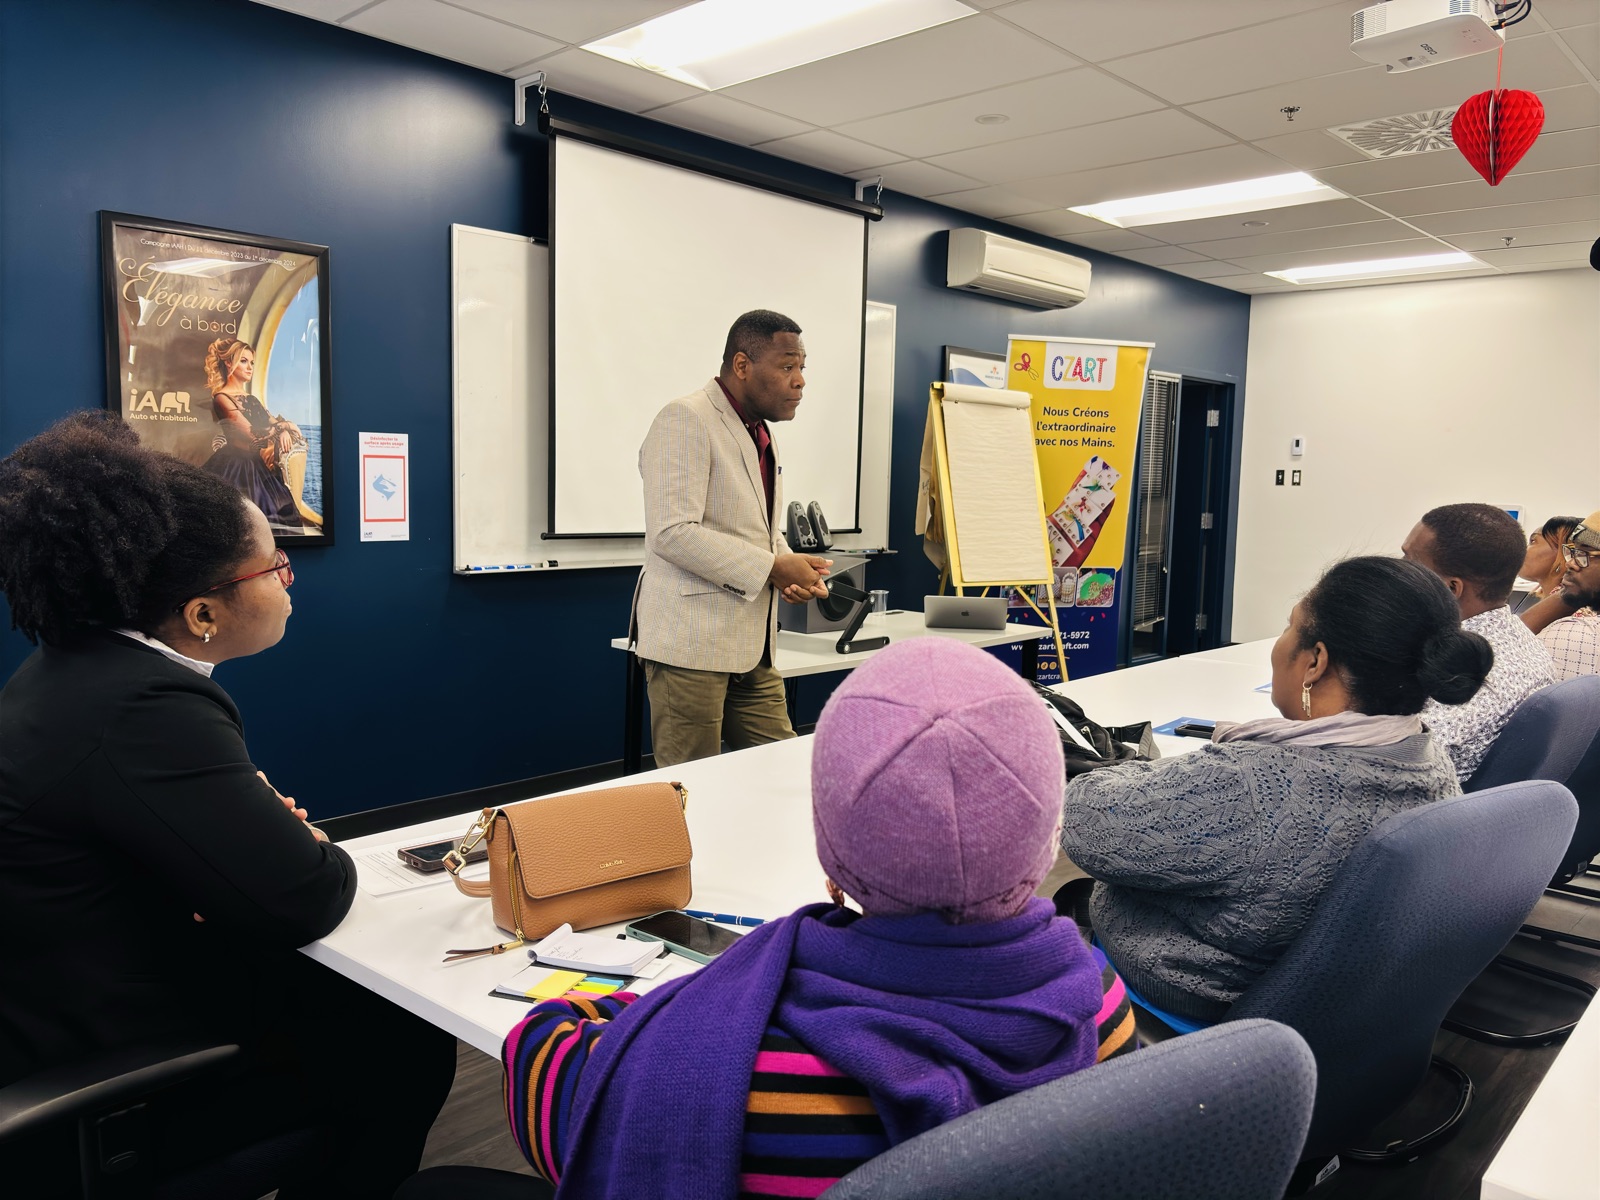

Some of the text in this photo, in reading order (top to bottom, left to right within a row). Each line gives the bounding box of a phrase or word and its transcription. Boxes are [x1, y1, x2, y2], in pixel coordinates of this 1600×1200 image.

[140, 238, 170, 248] Campagne
[204, 248, 229, 256] décembre
[230, 251, 244, 259] 2023
[283, 259, 296, 267] 2024
[118, 255, 244, 327] Élégance
[180, 315, 237, 334] à bord
[1051, 355, 1108, 384] CZART
[129, 412, 148, 420] Auto
[159, 414, 198, 423] habitation
[1042, 406, 1110, 418] Nous Créons
[1036, 420, 1116, 433] l'extraordinaire
[1035, 437, 1115, 448] avec nos Mains.
